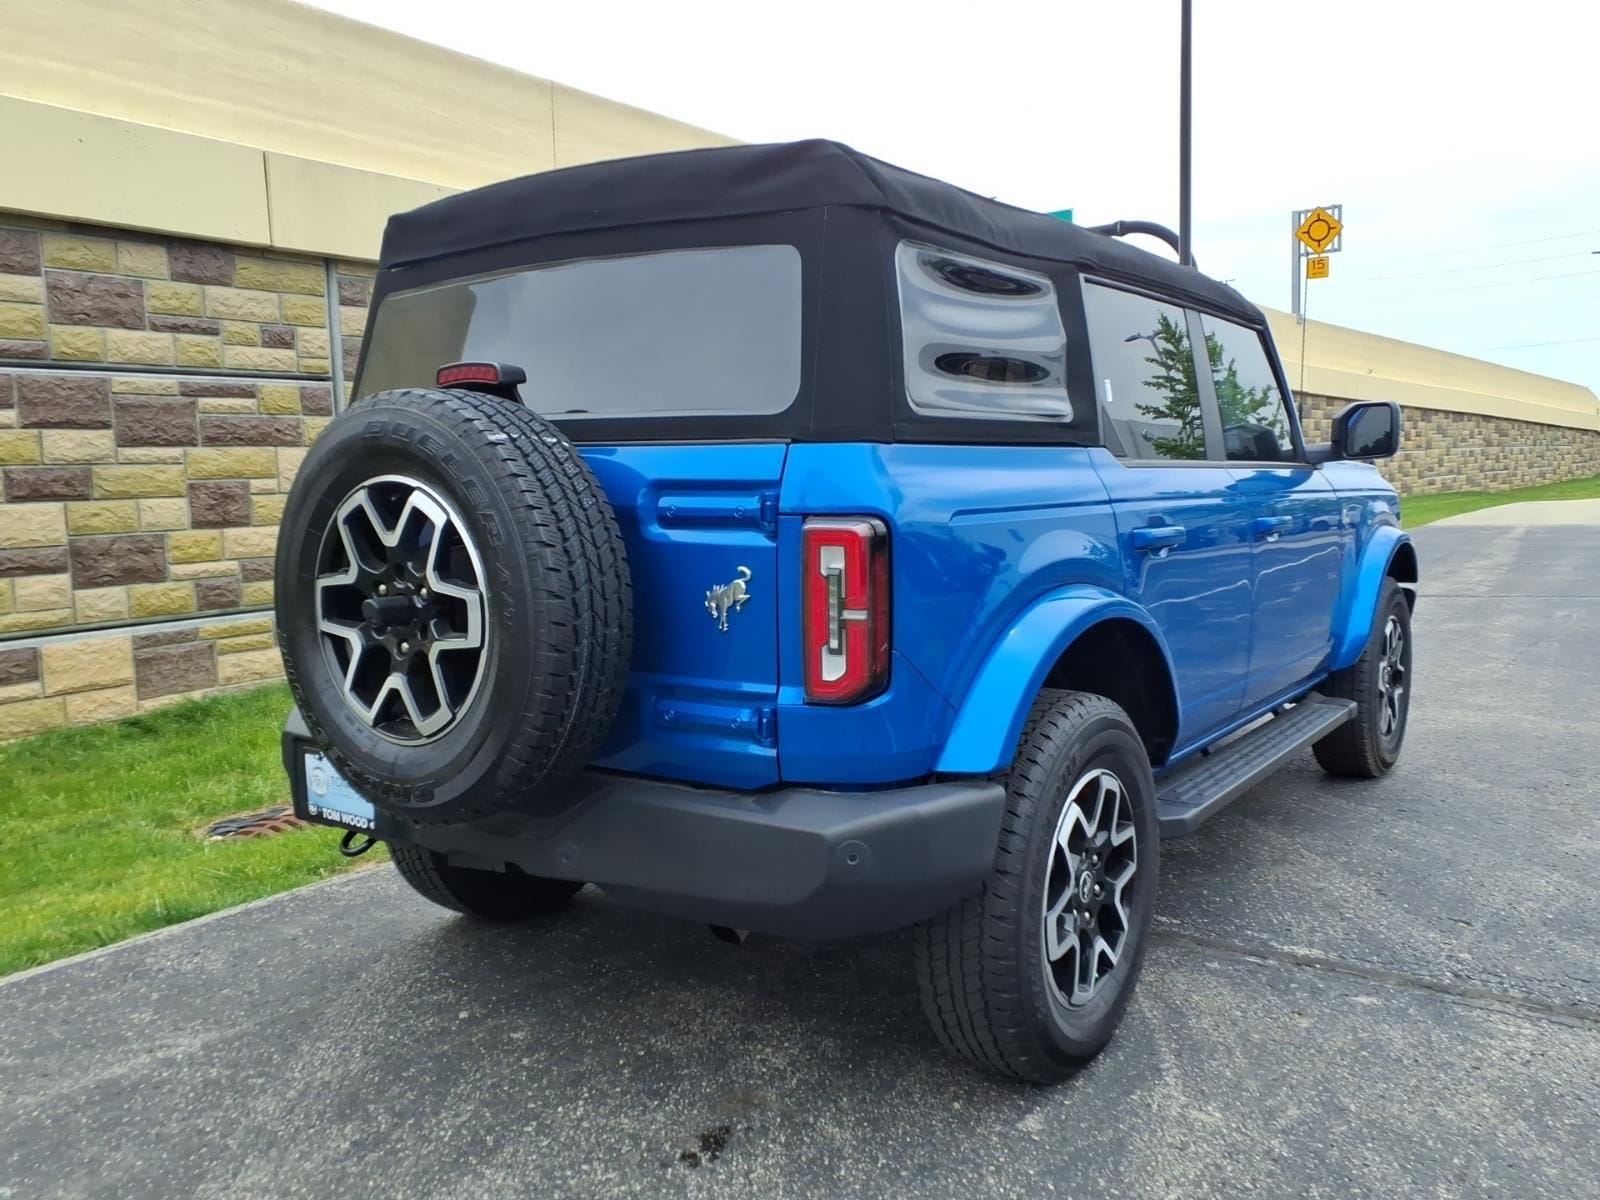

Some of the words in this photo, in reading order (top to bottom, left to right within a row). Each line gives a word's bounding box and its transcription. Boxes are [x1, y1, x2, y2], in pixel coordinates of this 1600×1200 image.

[1312, 259, 1326, 270] 15
[322, 807, 340, 822] TOM
[341, 812, 368, 829] WOOD
